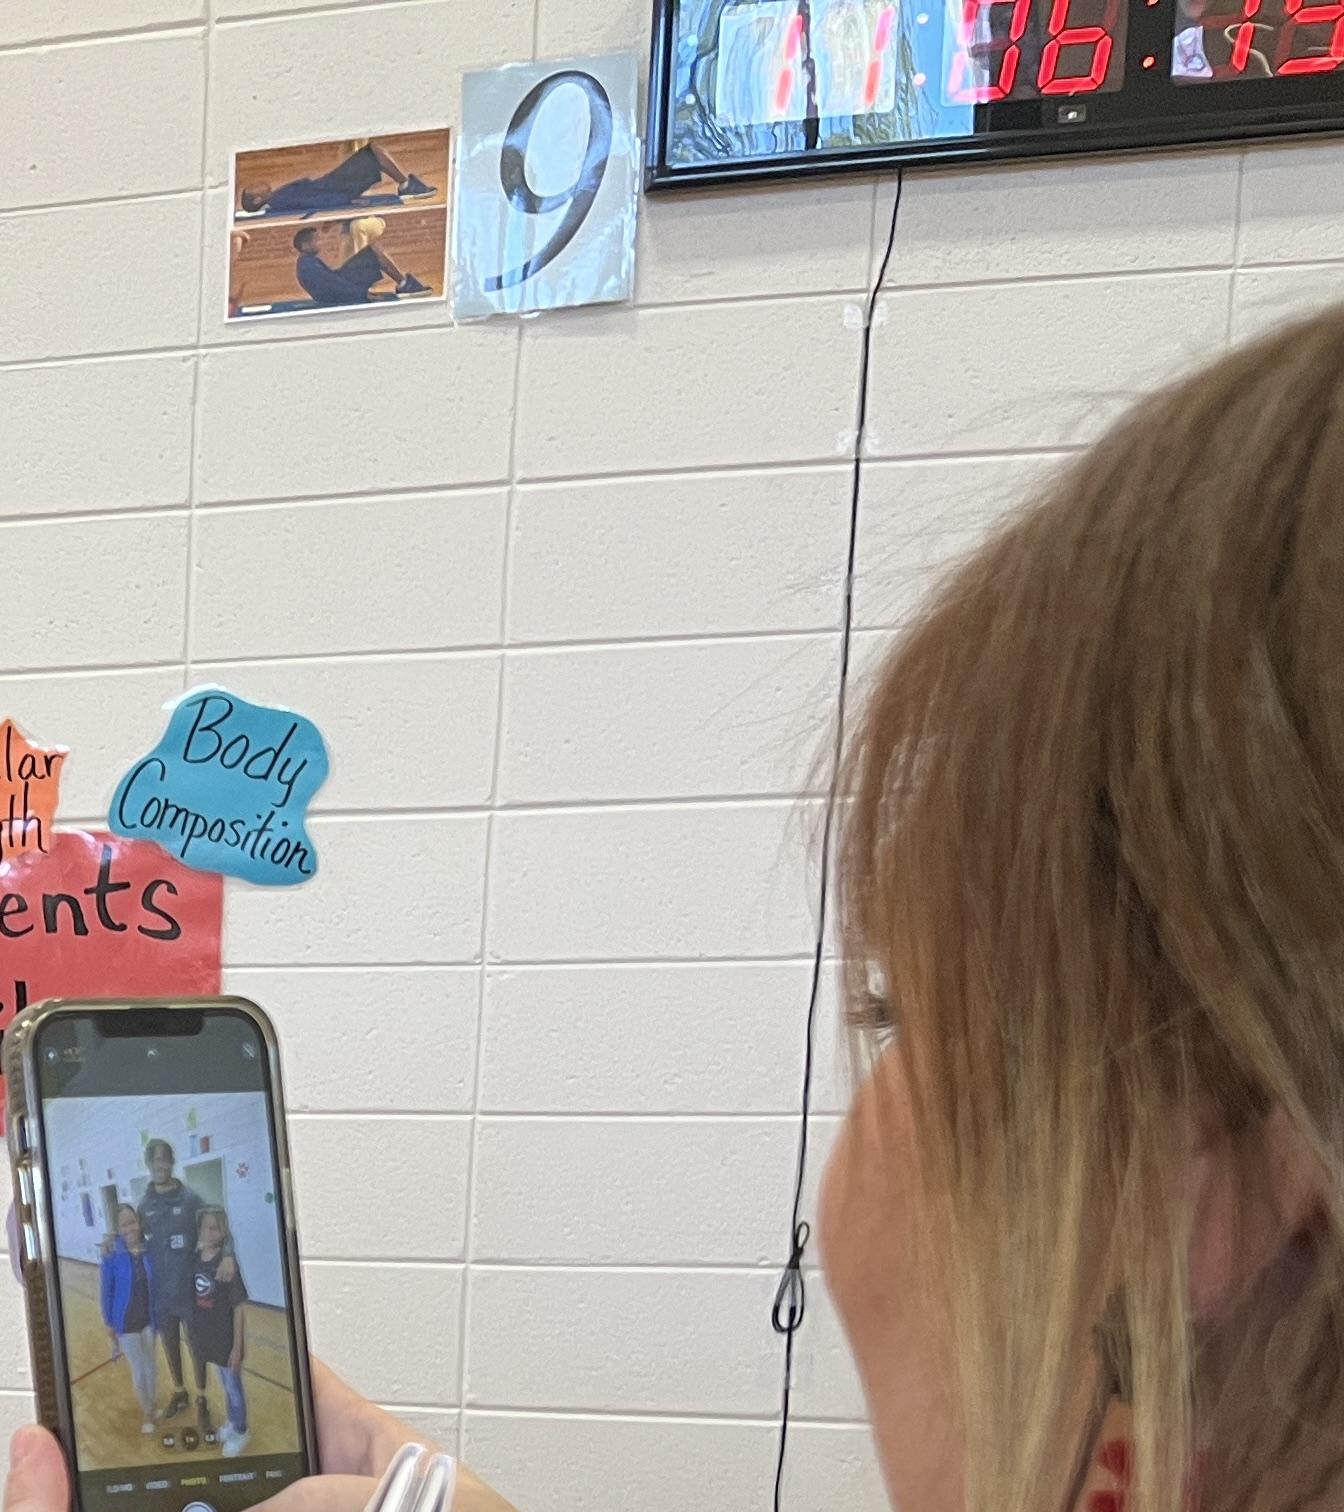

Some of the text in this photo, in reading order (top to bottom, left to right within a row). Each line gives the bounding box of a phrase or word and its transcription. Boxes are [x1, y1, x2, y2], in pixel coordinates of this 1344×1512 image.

[483, 70, 612, 293] 9
[184, 695, 308, 808] Body
[119, 758, 311, 874] Composition
